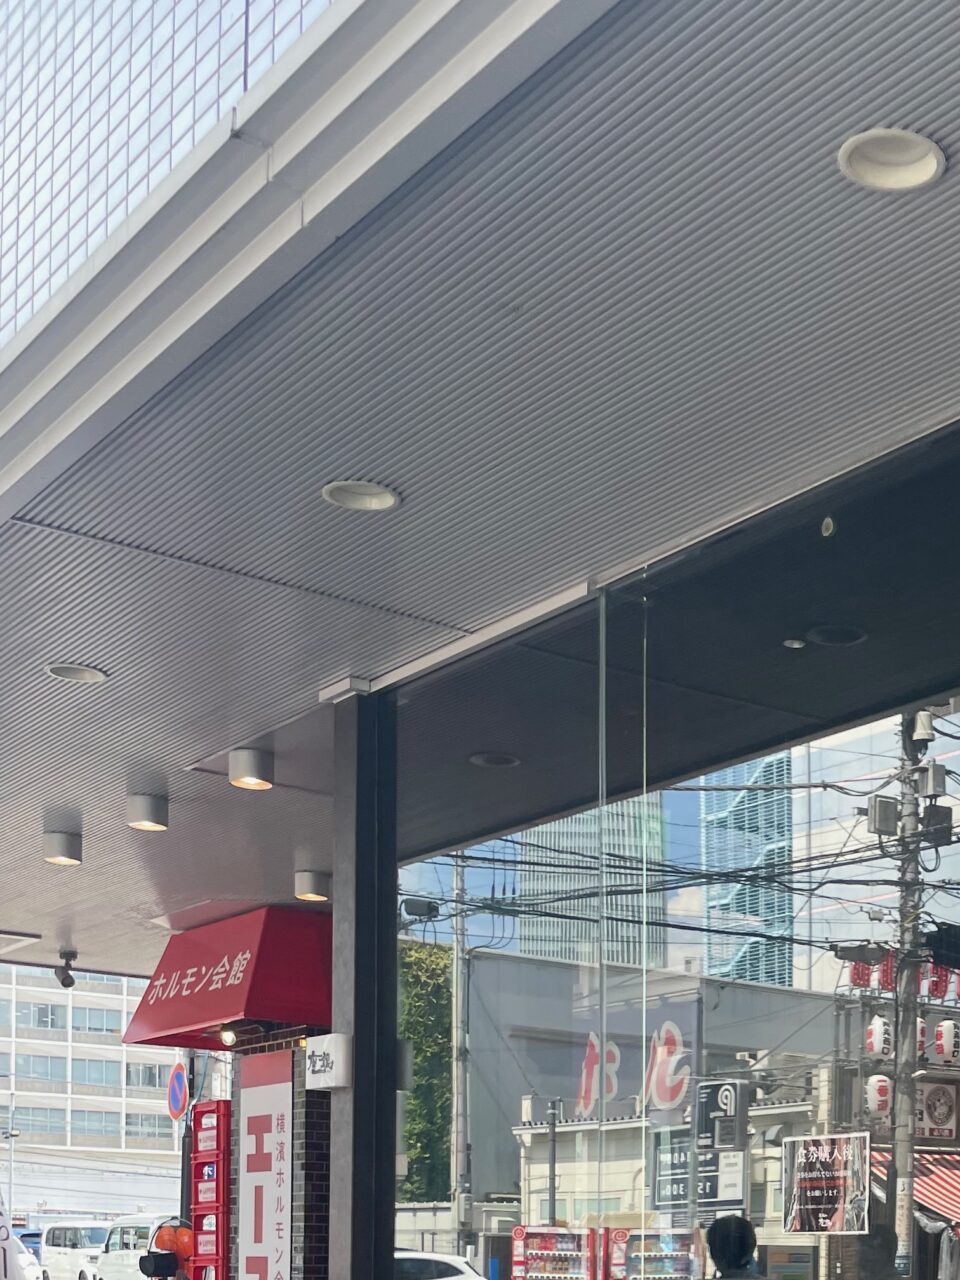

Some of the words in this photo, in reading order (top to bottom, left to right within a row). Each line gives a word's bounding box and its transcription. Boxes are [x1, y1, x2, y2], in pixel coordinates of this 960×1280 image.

[148, 950, 251, 1005] ホルモン会館
